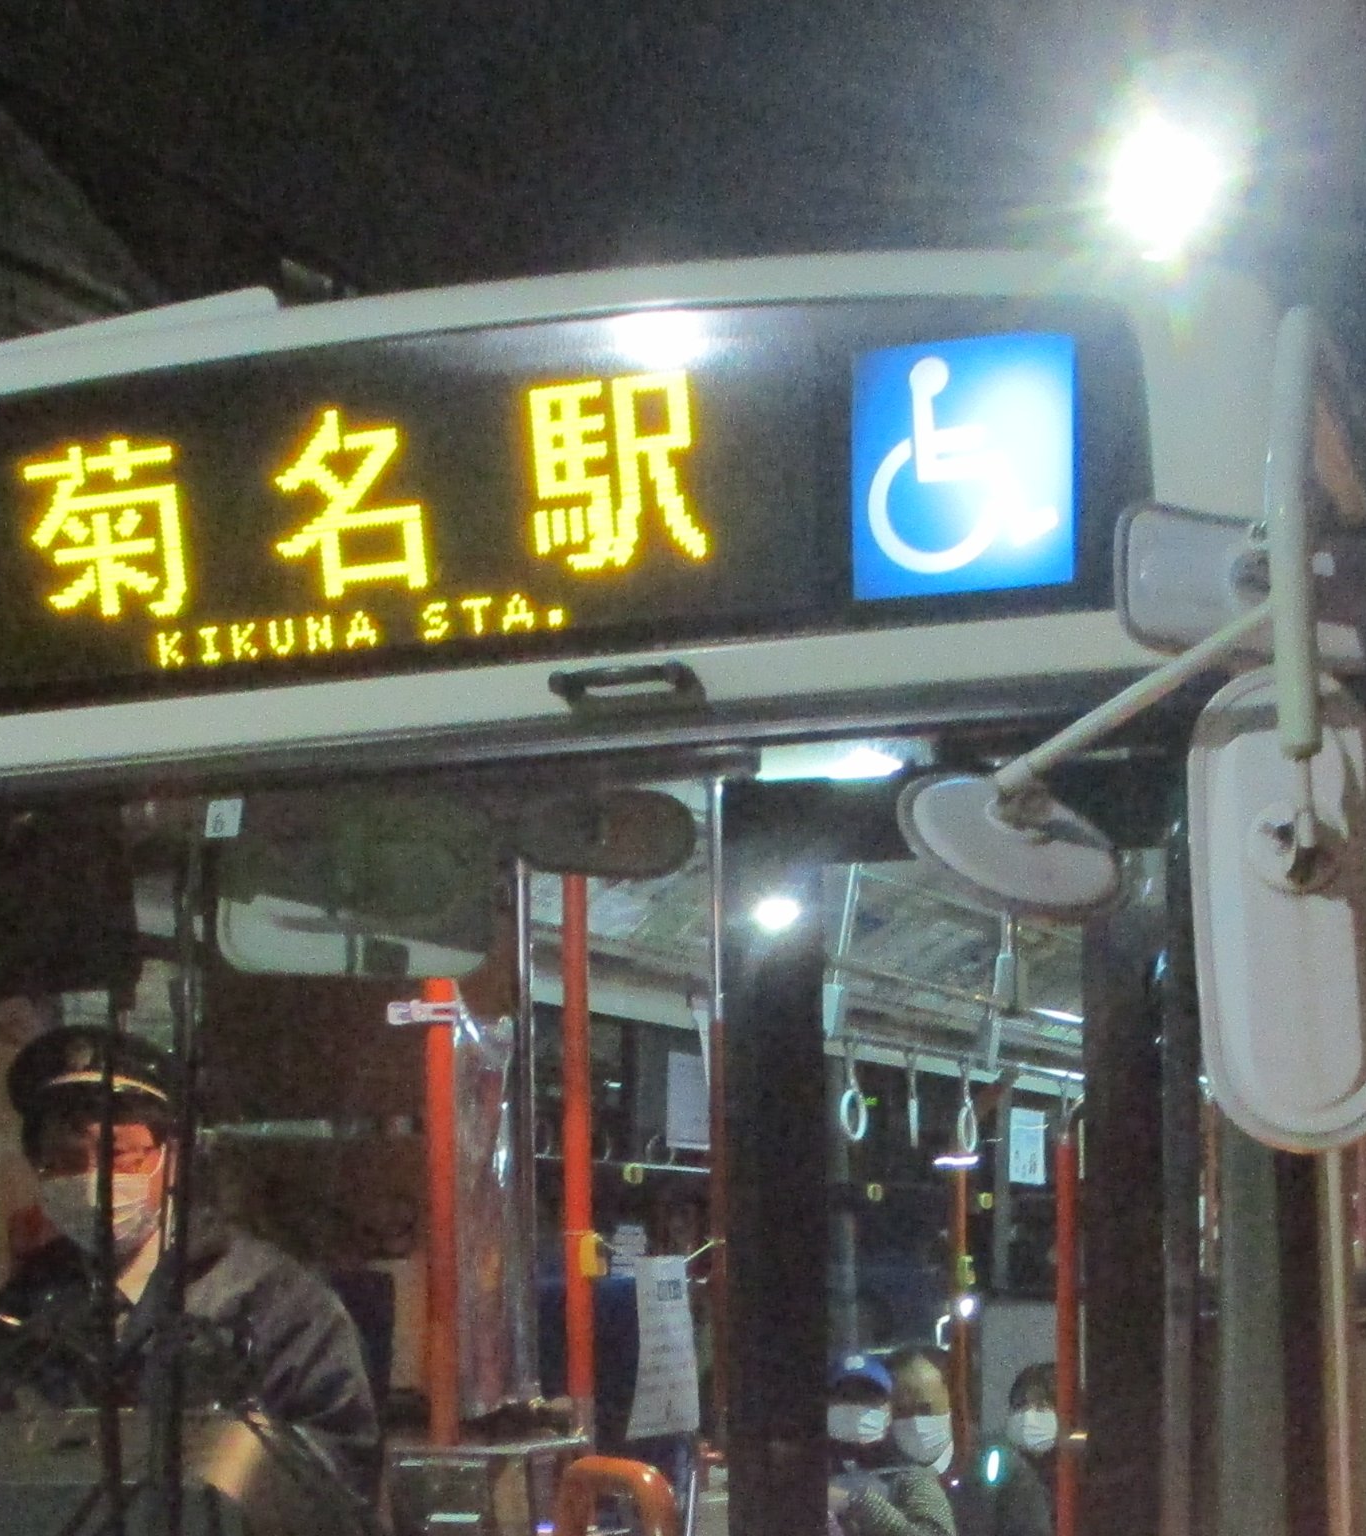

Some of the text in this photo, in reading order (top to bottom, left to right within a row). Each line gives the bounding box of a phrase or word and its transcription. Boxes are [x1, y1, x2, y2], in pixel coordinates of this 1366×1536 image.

[21, 370, 710, 618] 菊名駅
[157, 592, 569, 669] KIKUNA STA.
